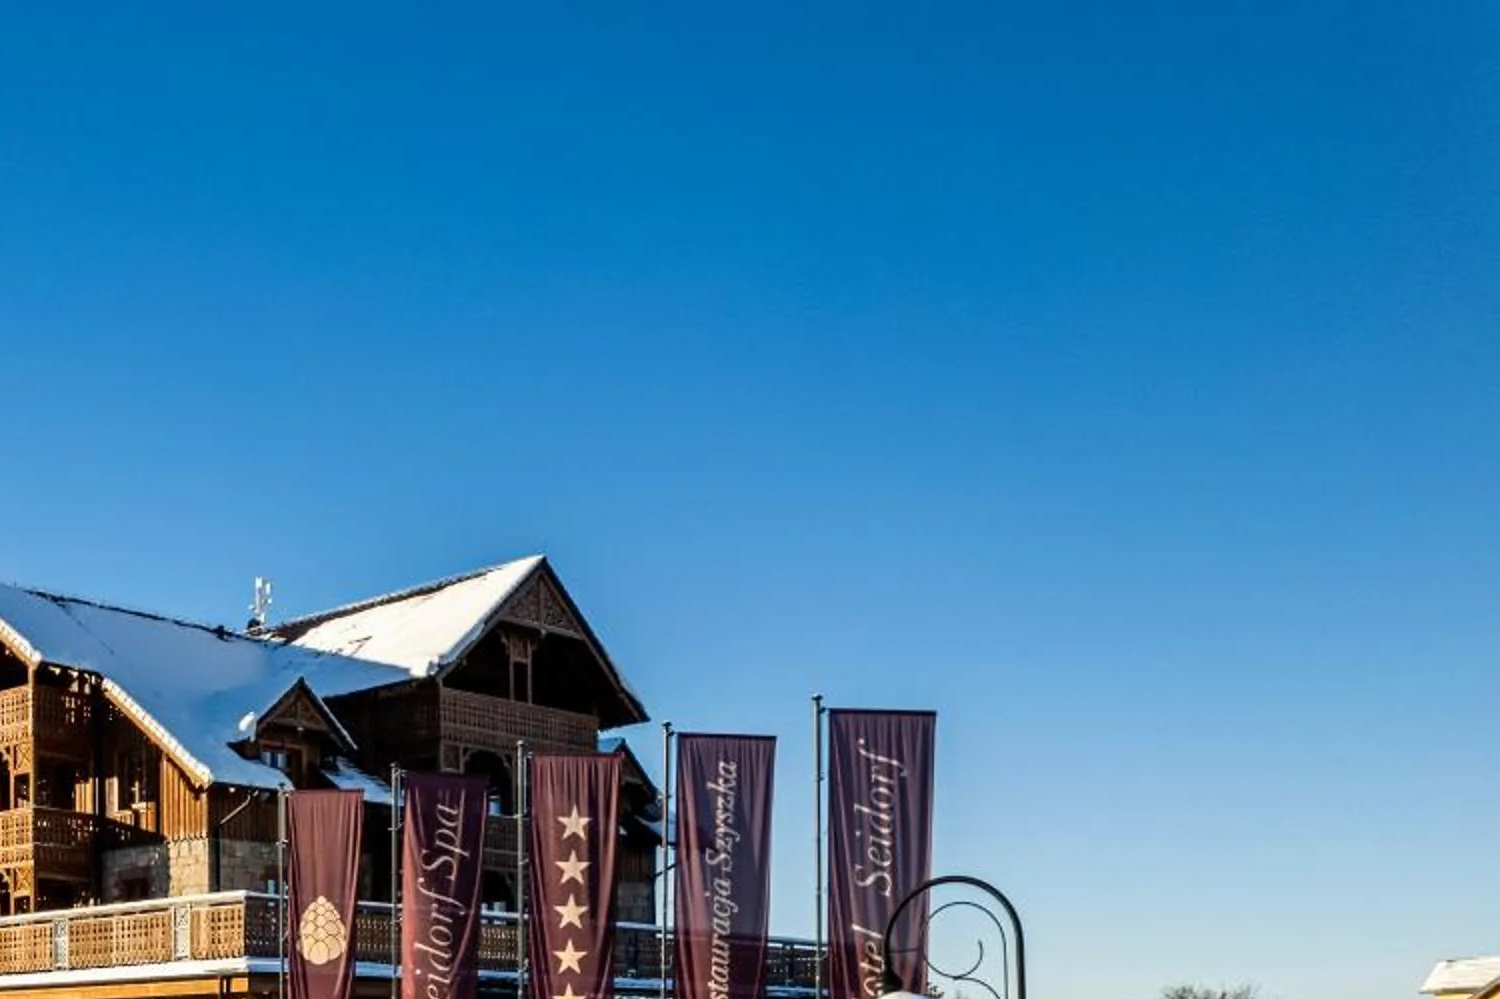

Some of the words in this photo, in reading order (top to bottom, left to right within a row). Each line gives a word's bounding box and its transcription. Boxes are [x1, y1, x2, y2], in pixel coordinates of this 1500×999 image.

[420, 803, 470, 881] Spa
[705, 760, 740, 873] Szyszka
[853, 737, 909, 897] Seidorf
